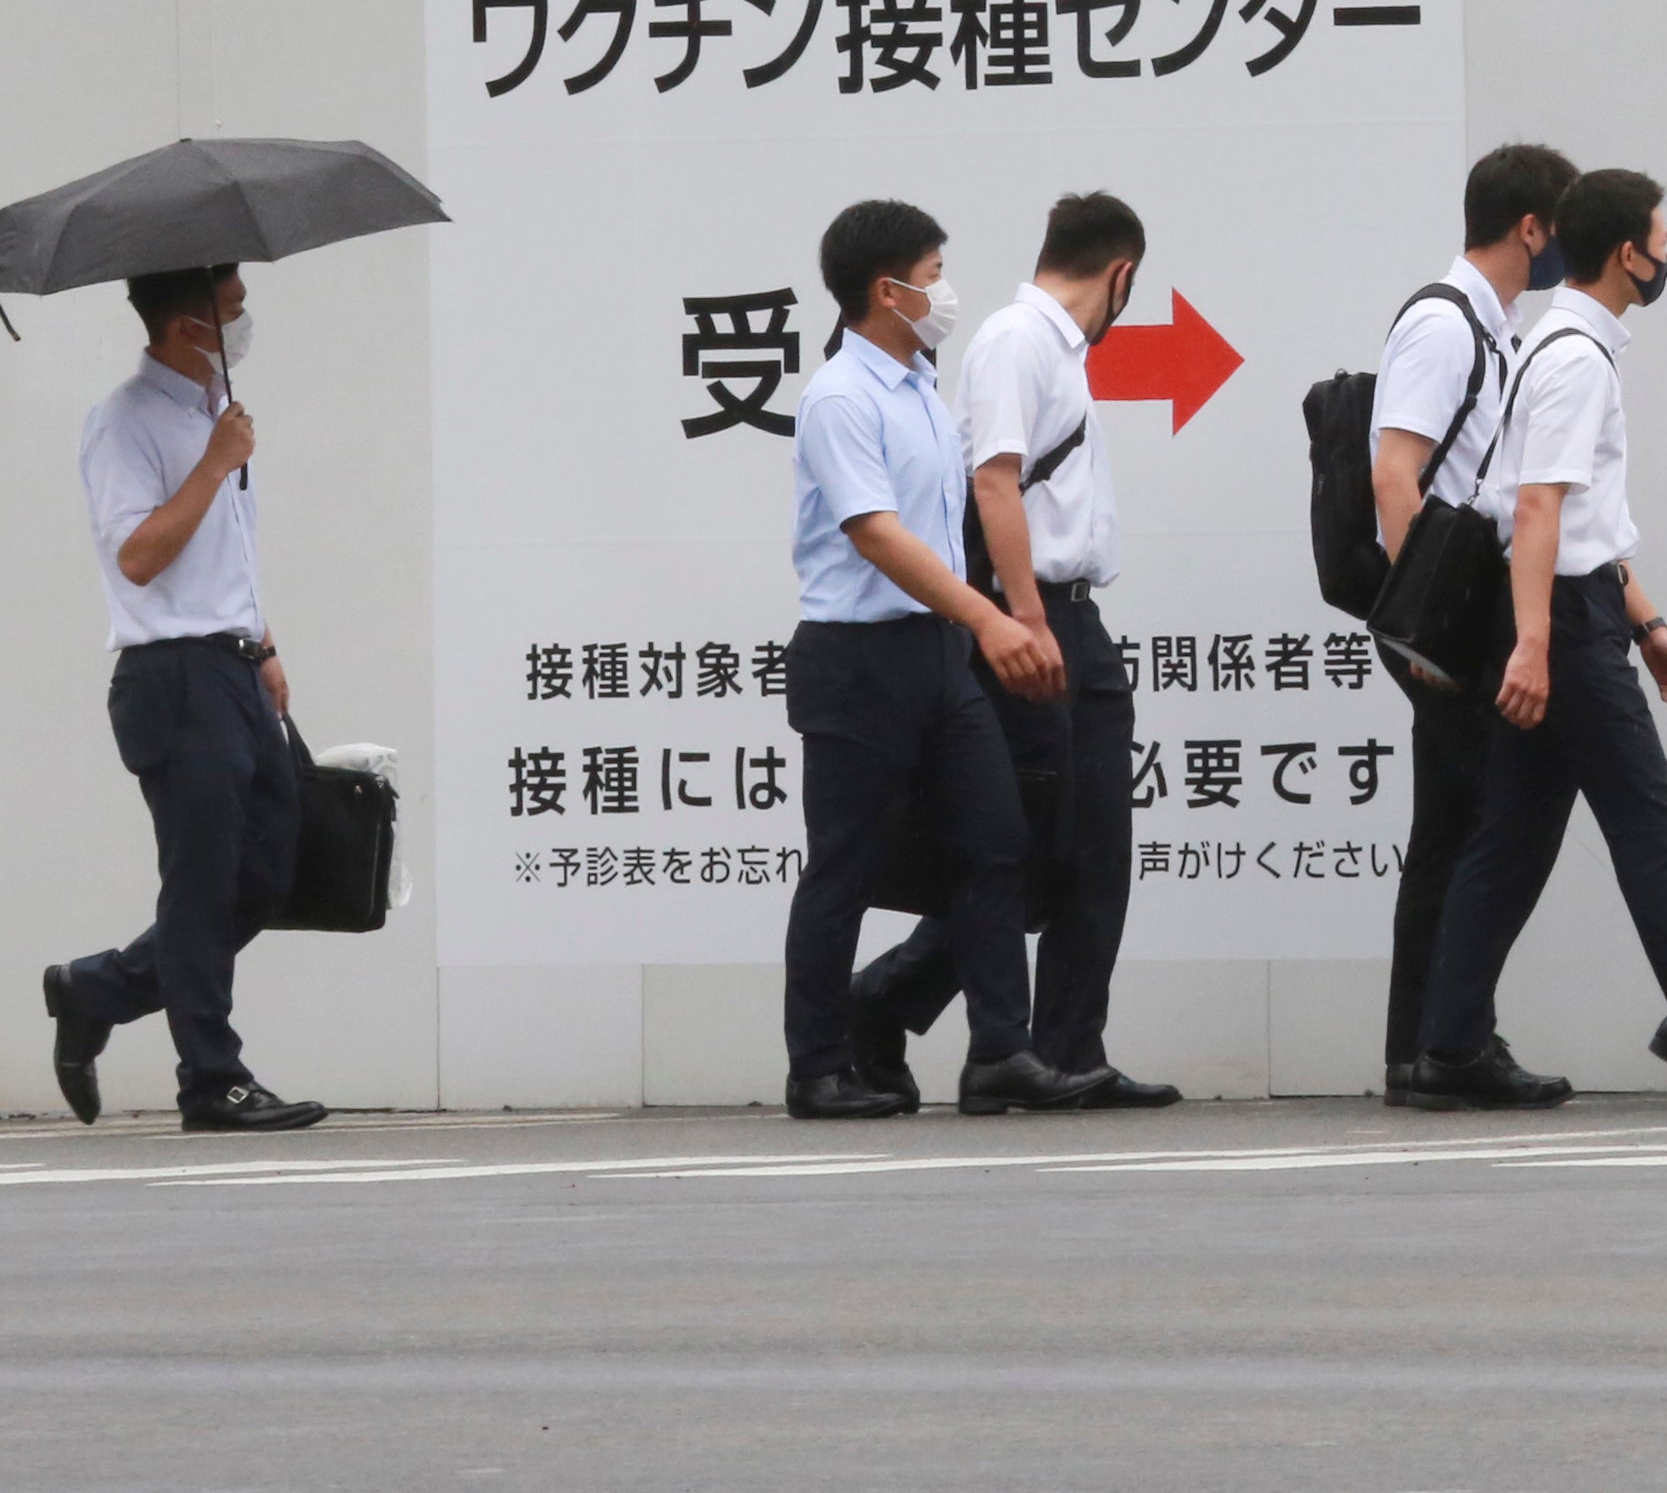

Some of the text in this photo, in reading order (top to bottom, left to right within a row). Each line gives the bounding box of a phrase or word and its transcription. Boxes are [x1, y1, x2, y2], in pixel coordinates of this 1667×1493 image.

[526, 640, 787, 701] 接種対象者
[508, 745, 788, 817] 接種には
[1138, 839, 1404, 881] 声がけください
